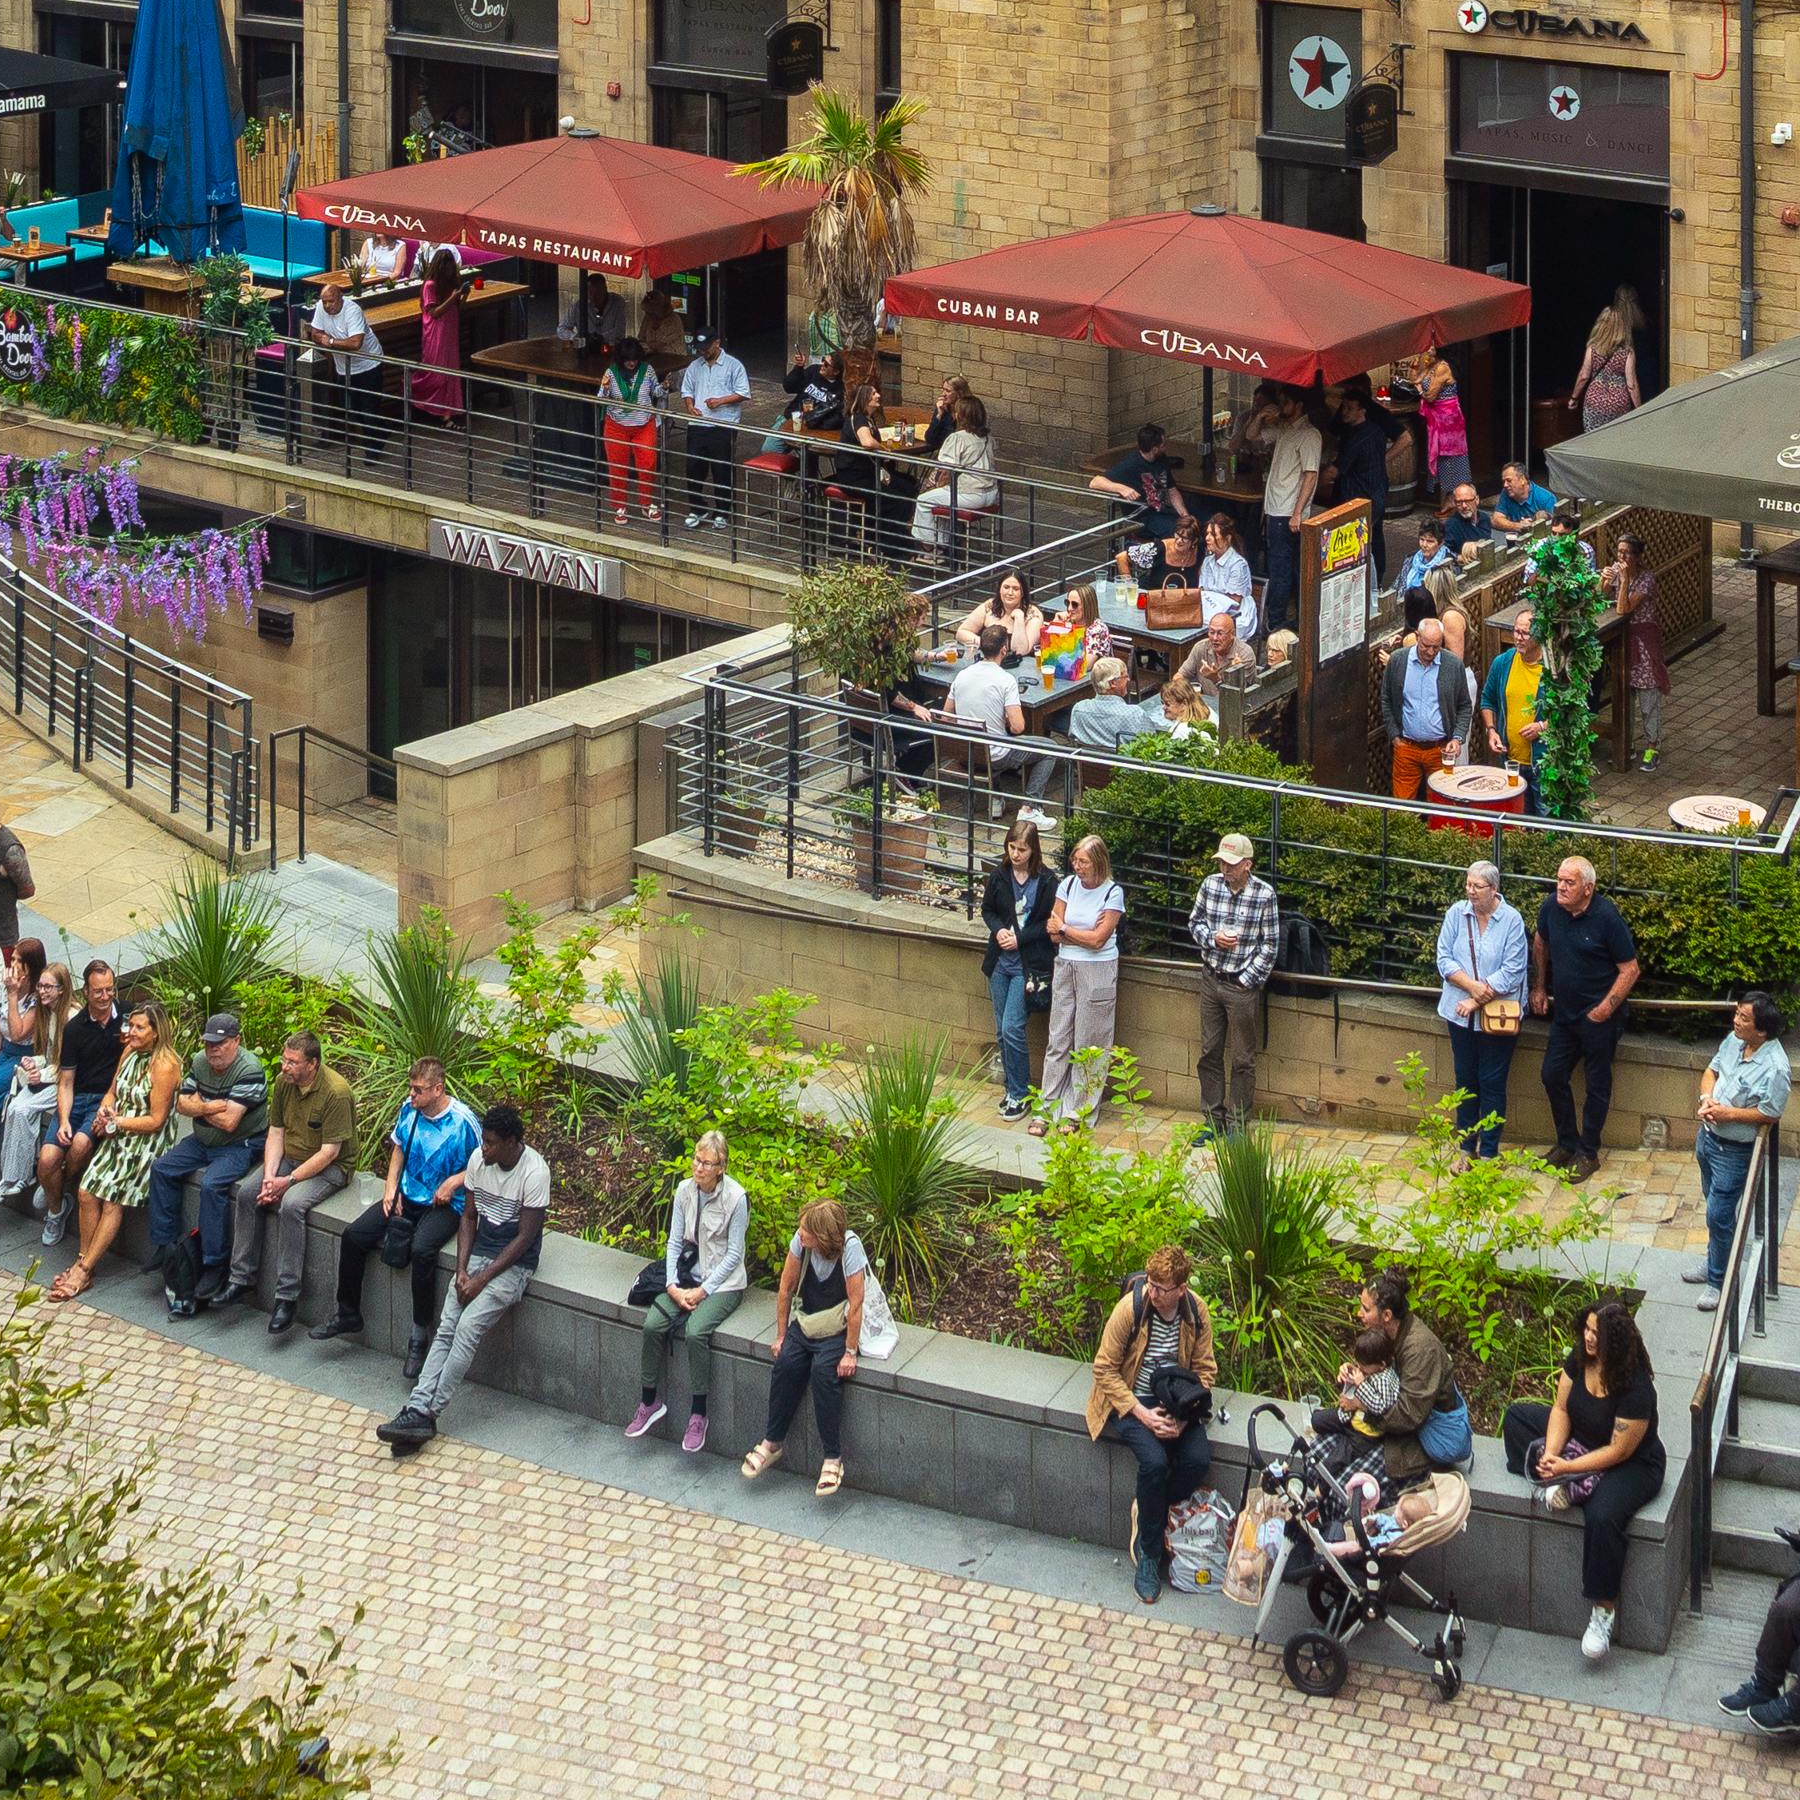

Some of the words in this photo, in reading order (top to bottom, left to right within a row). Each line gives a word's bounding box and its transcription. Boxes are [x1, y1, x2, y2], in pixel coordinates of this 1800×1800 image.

[1490, 9, 1649, 43] CUBANA
[1531, 131, 1573, 144] MUSIC
[1585, 130, 1599, 148] &
[1607, 139, 1654, 153] DANCE
[324, 204, 427, 233] CUBANA
[479, 229, 527, 249] TAPAS
[533, 238, 633, 269] RESTAURANT
[937, 298, 997, 319] CUBAN
[1005, 307, 1040, 325] BAR
[1140, 329, 1270, 369] CUBANA
